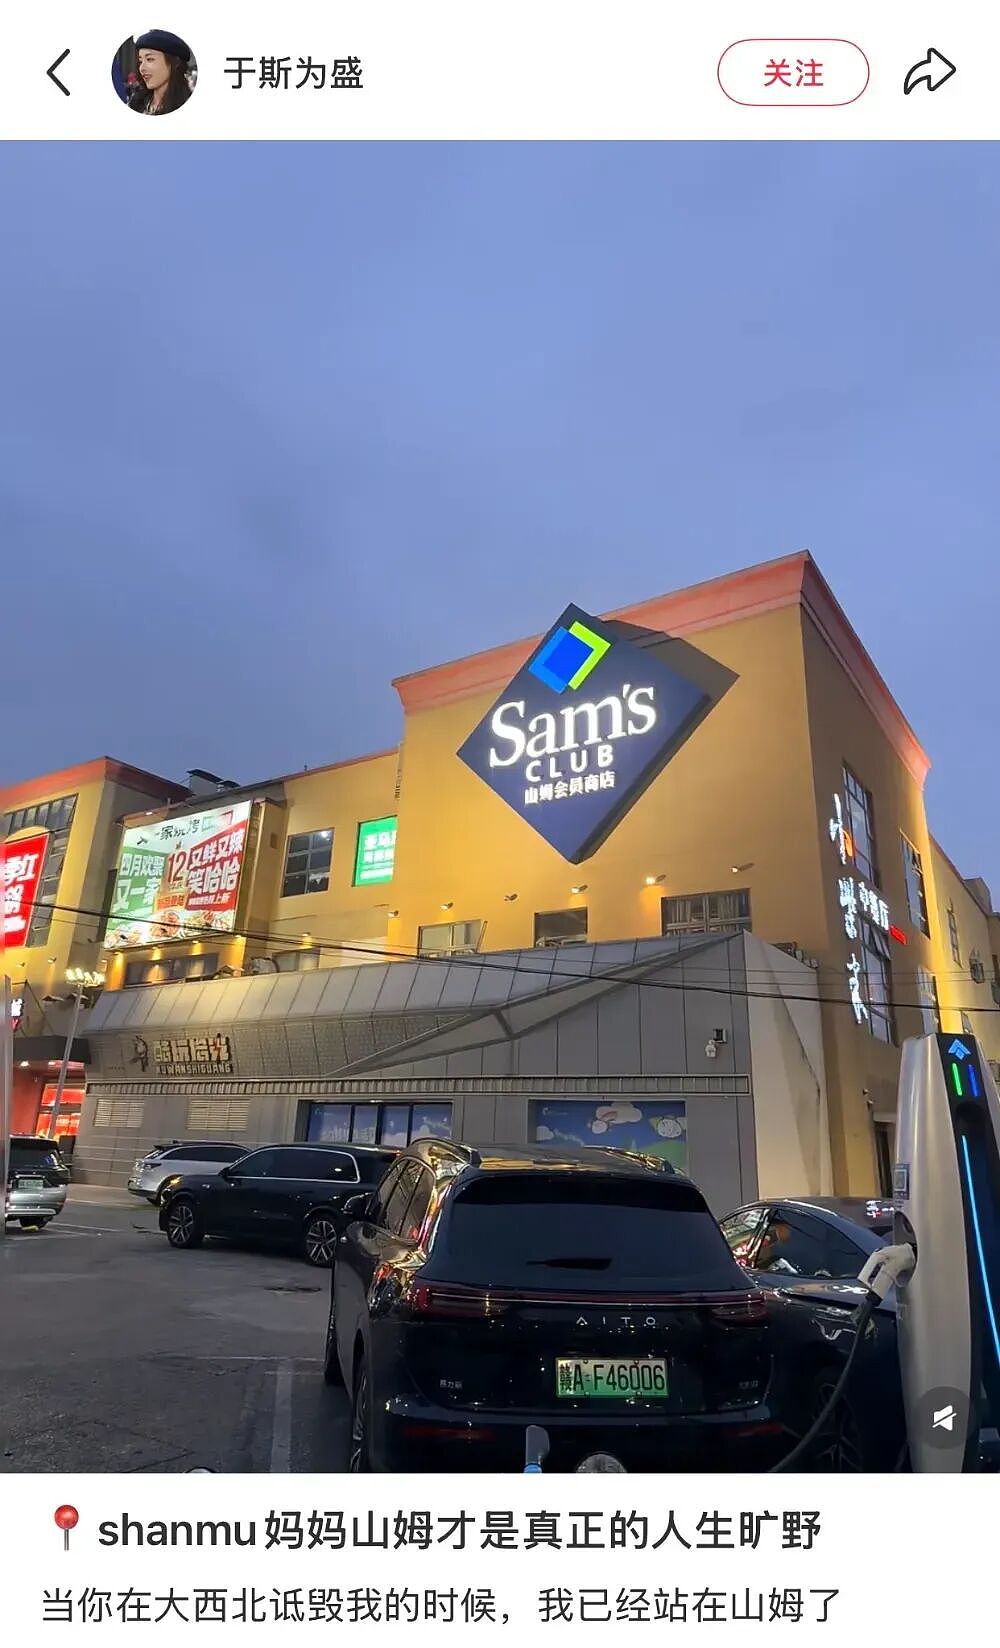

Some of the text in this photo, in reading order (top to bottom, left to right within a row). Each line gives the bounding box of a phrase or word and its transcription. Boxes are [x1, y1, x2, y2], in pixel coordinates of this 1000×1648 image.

[488, 683, 657, 768] Sam's
[525, 744, 614, 782] CLUB
[524, 770, 616, 804] 山姆会员商店
[119, 852, 165, 877] 四月欢聚
[188, 828, 246, 872] 又鲜又辣
[188, 855, 241, 895] 笑哈哈
[112, 876, 161, 913] 又一家
[576, 1315, 657, 1326] AITO
